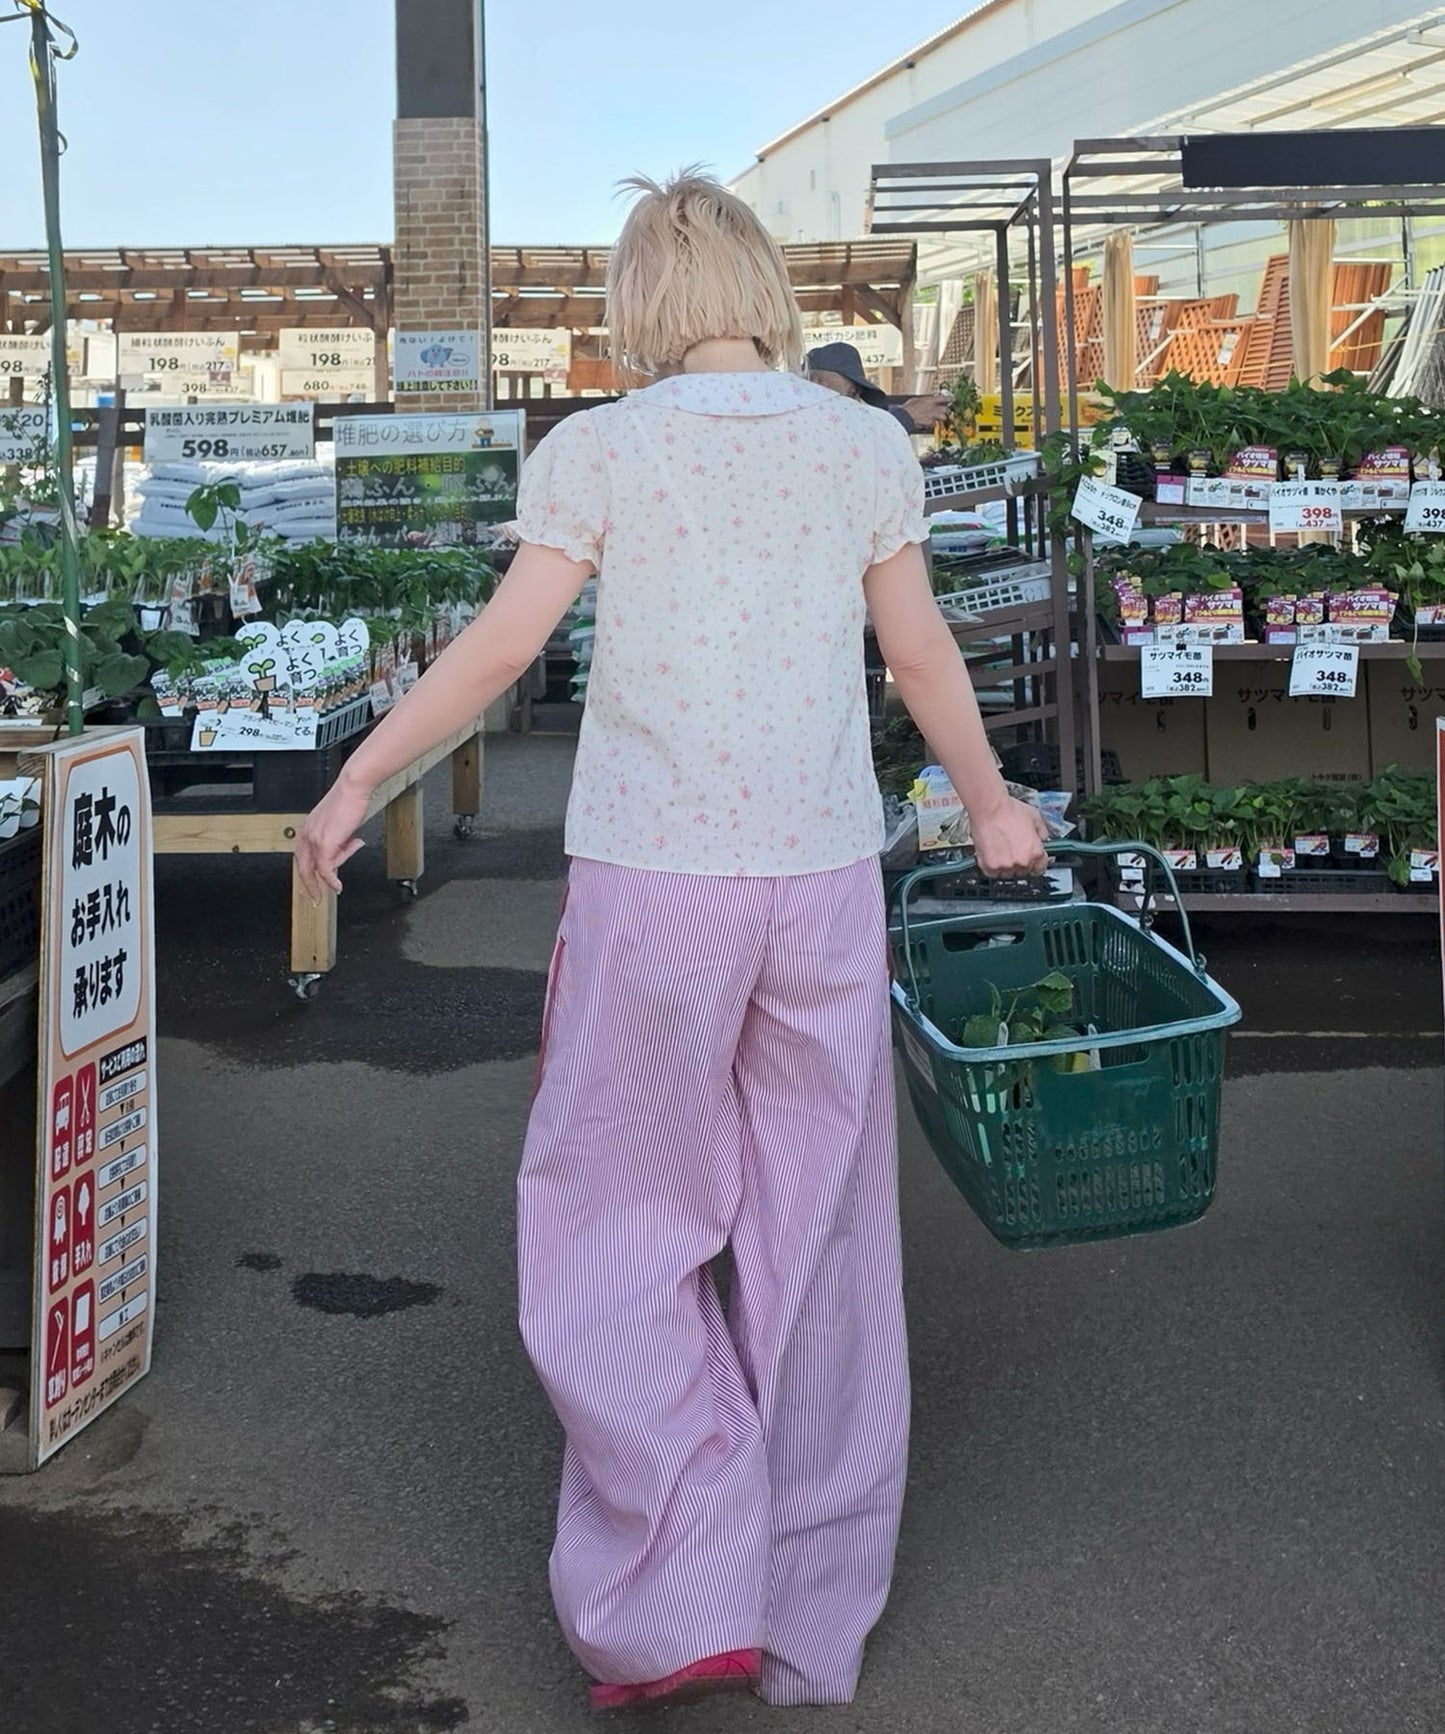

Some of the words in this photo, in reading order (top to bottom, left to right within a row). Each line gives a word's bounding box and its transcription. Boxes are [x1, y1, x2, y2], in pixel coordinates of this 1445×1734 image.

[336, 419, 467, 447] 堆肥の選び方
[1150, 651, 1202, 661] サツマイモ苗
[1296, 650, 1352, 661] バイオサツマ苗
[71, 786, 131, 871] 庭木の
[70, 880, 131, 949] お手入れ
[72, 948, 128, 1020] 承ります
